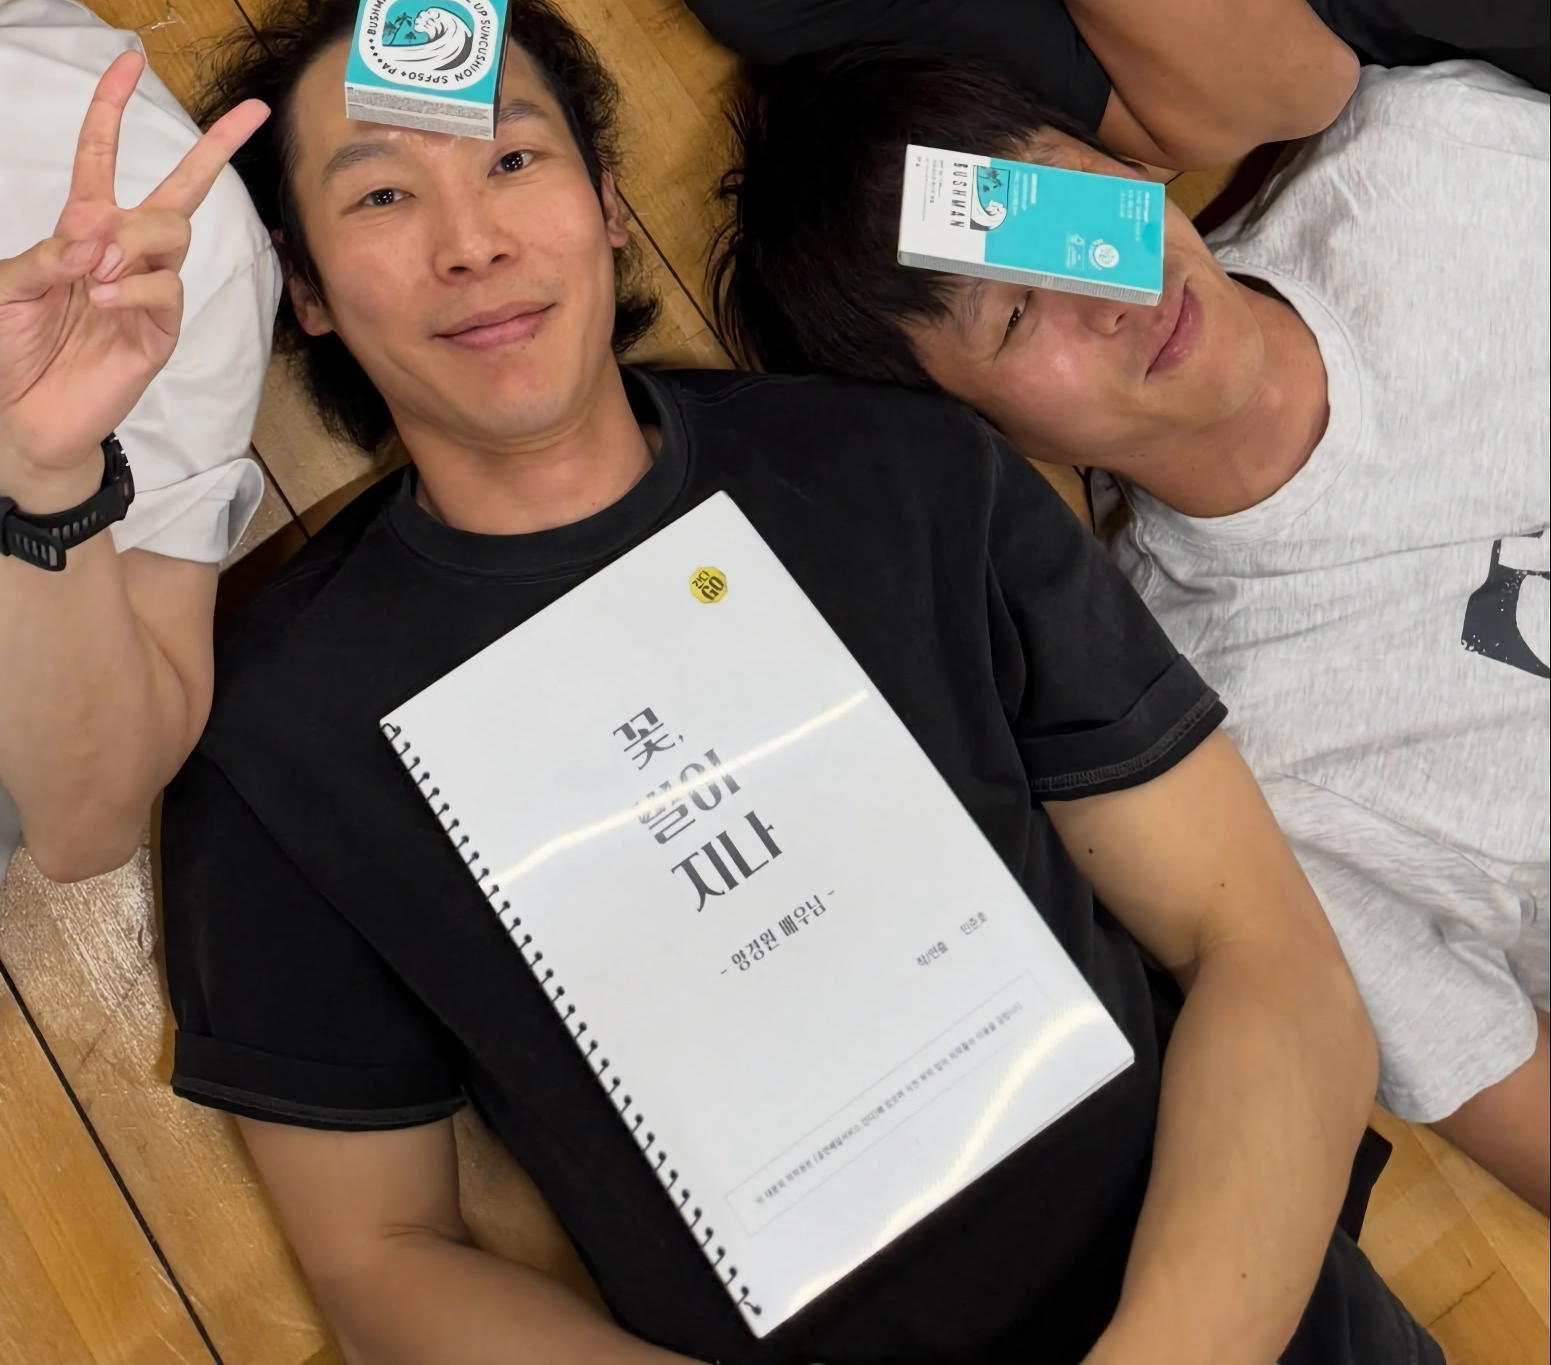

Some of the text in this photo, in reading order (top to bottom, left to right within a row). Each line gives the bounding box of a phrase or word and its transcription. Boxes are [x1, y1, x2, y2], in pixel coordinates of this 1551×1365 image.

[473, 2, 488, 17] UP
[454, 19, 491, 82] SUNCUSHION
[949, 162, 968, 229] BUSHMAN
[701, 575, 725, 602] GO
[670, 810, 783, 913] 지나
[731, 928, 780, 972] 양경원
[778, 894, 827, 939] 배우님
